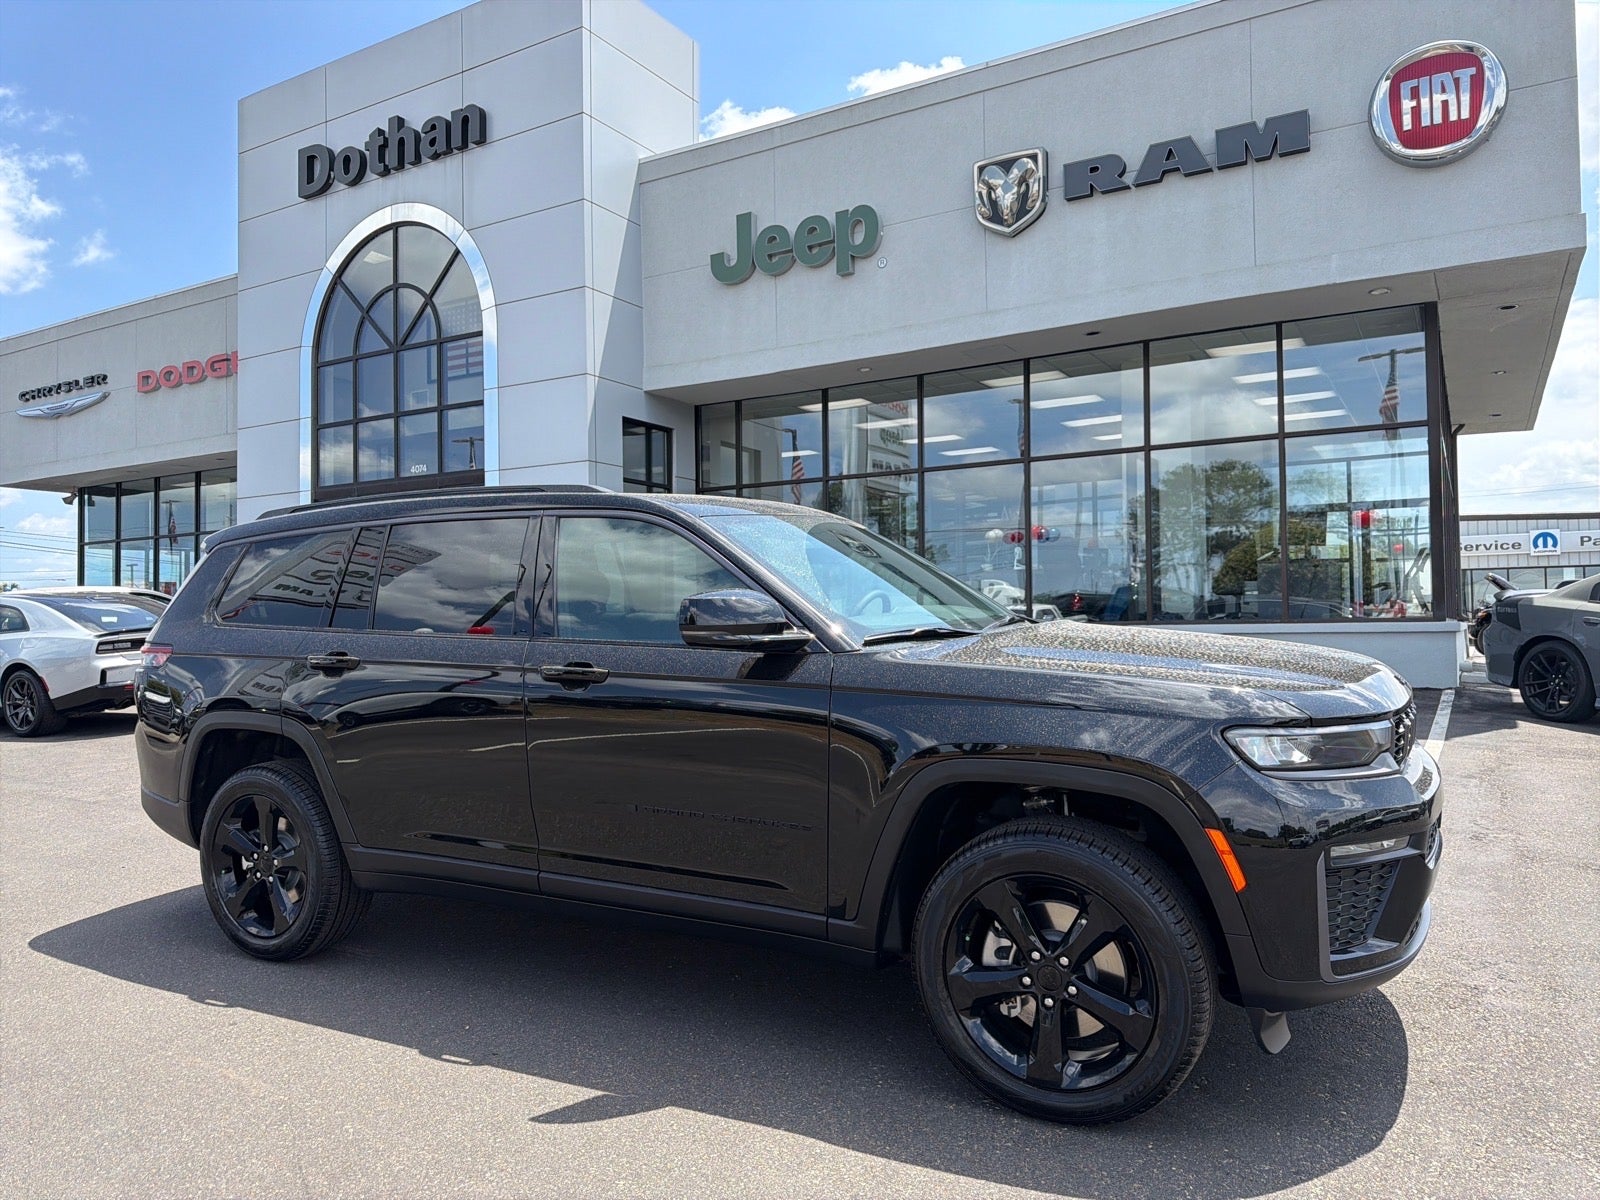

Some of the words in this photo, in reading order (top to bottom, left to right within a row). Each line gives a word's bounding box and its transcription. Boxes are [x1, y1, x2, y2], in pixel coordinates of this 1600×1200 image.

[1400, 67, 1477, 132] FIAT
[298, 103, 487, 200] Dothan
[1063, 109, 1311, 201] RAM
[710, 204, 883, 285] Jeep
[18, 373, 109, 403] CHRYSLER
[410, 464, 427, 473] 4074
[1459, 540, 1522, 552] ervice
